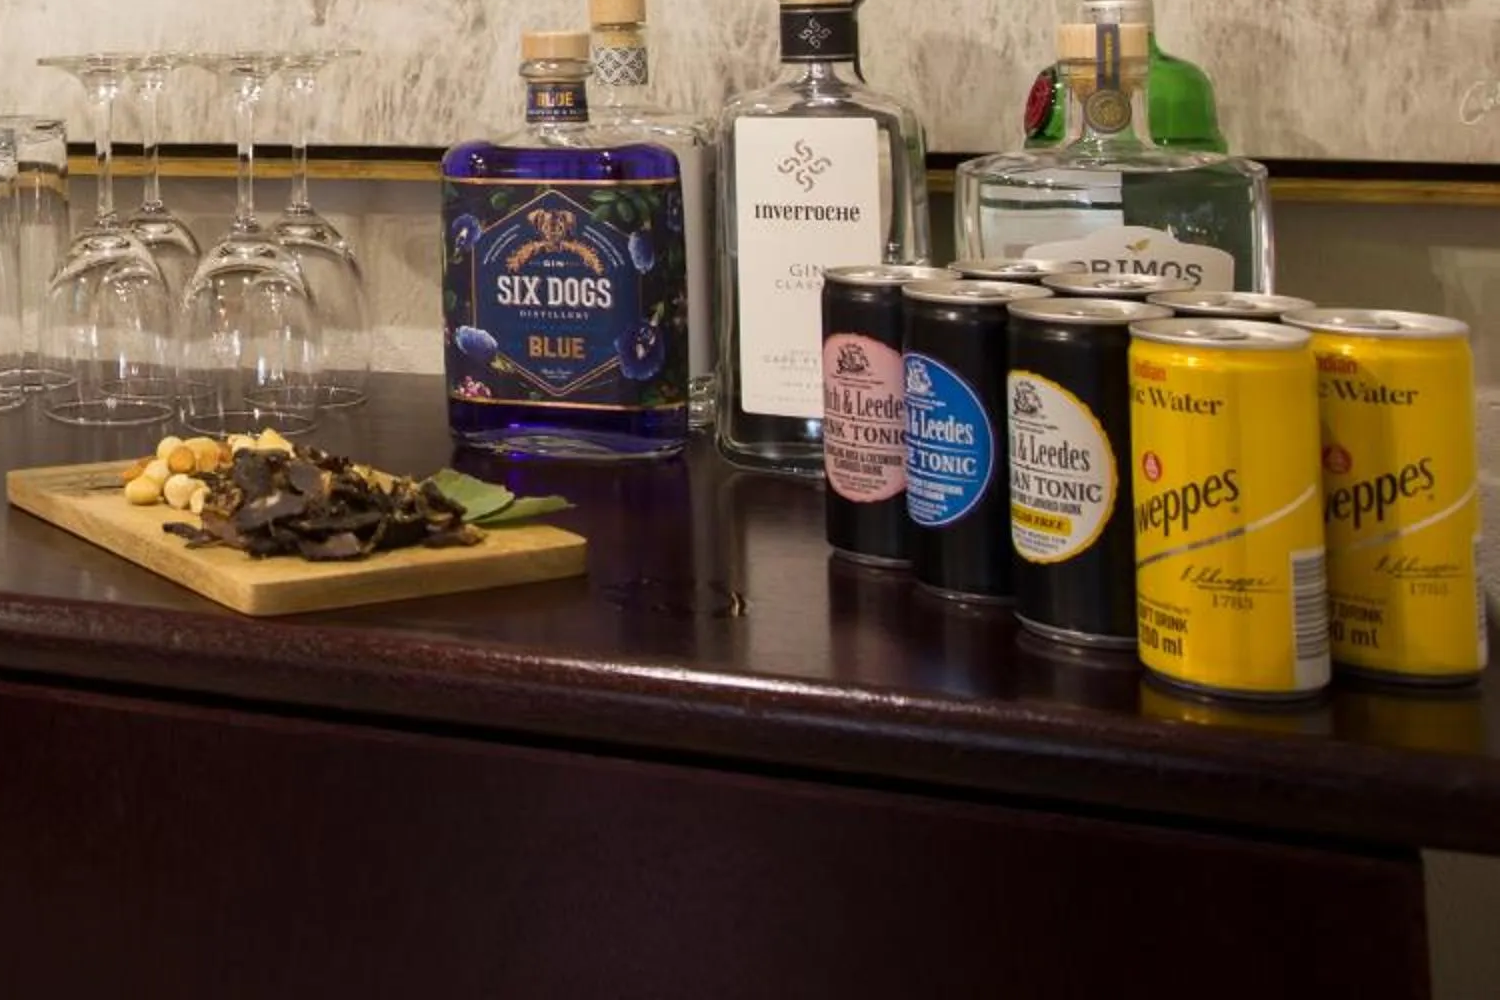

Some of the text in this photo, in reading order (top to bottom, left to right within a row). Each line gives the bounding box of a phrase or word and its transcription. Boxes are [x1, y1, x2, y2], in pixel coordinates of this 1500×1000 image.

[496, 274, 613, 309] SIX DOGS
[527, 334, 587, 360] BLUE
[856, 390, 905, 419] Leede
[1148, 386, 1225, 416] Water
[1332, 378, 1420, 405] Water
[920, 410, 975, 446] Leedes
[919, 451, 978, 477] TONIC
[1030, 434, 1092, 472] Leedes
[1034, 475, 1103, 505] TONIC
[1138, 468, 1241, 538] weppes
[1162, 637, 1184, 657] ml
